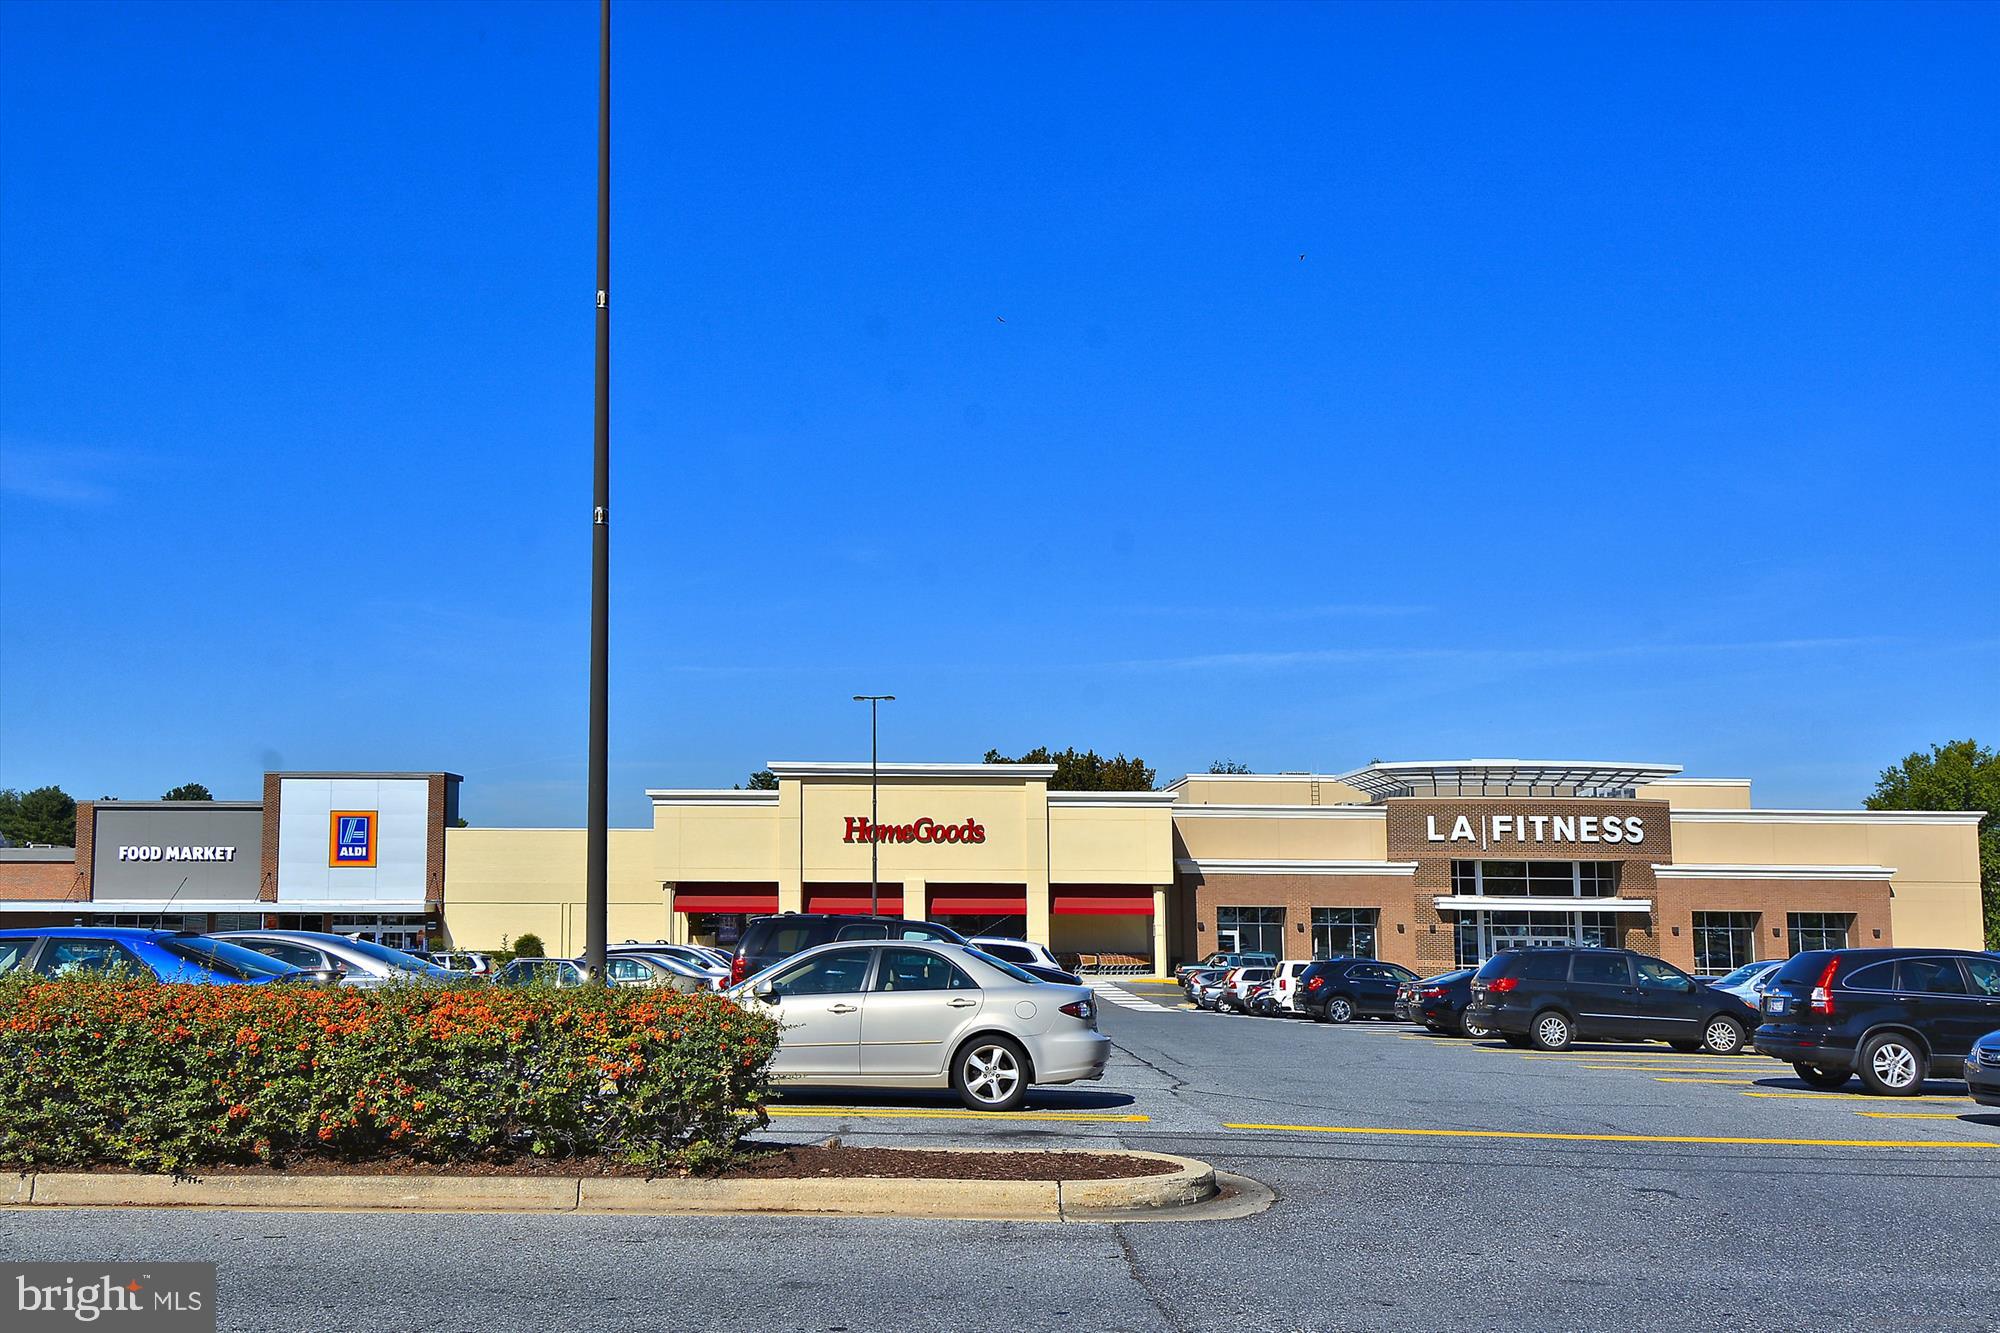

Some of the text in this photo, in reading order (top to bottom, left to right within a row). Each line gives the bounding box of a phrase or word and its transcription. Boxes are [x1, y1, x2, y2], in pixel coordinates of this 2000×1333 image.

[843, 816, 986, 844] HomeGoods
[1426, 815, 1644, 843] LA FITNESS
[119, 846, 236, 862] FOOD MARKET
[340, 847, 366, 856] ALDI
